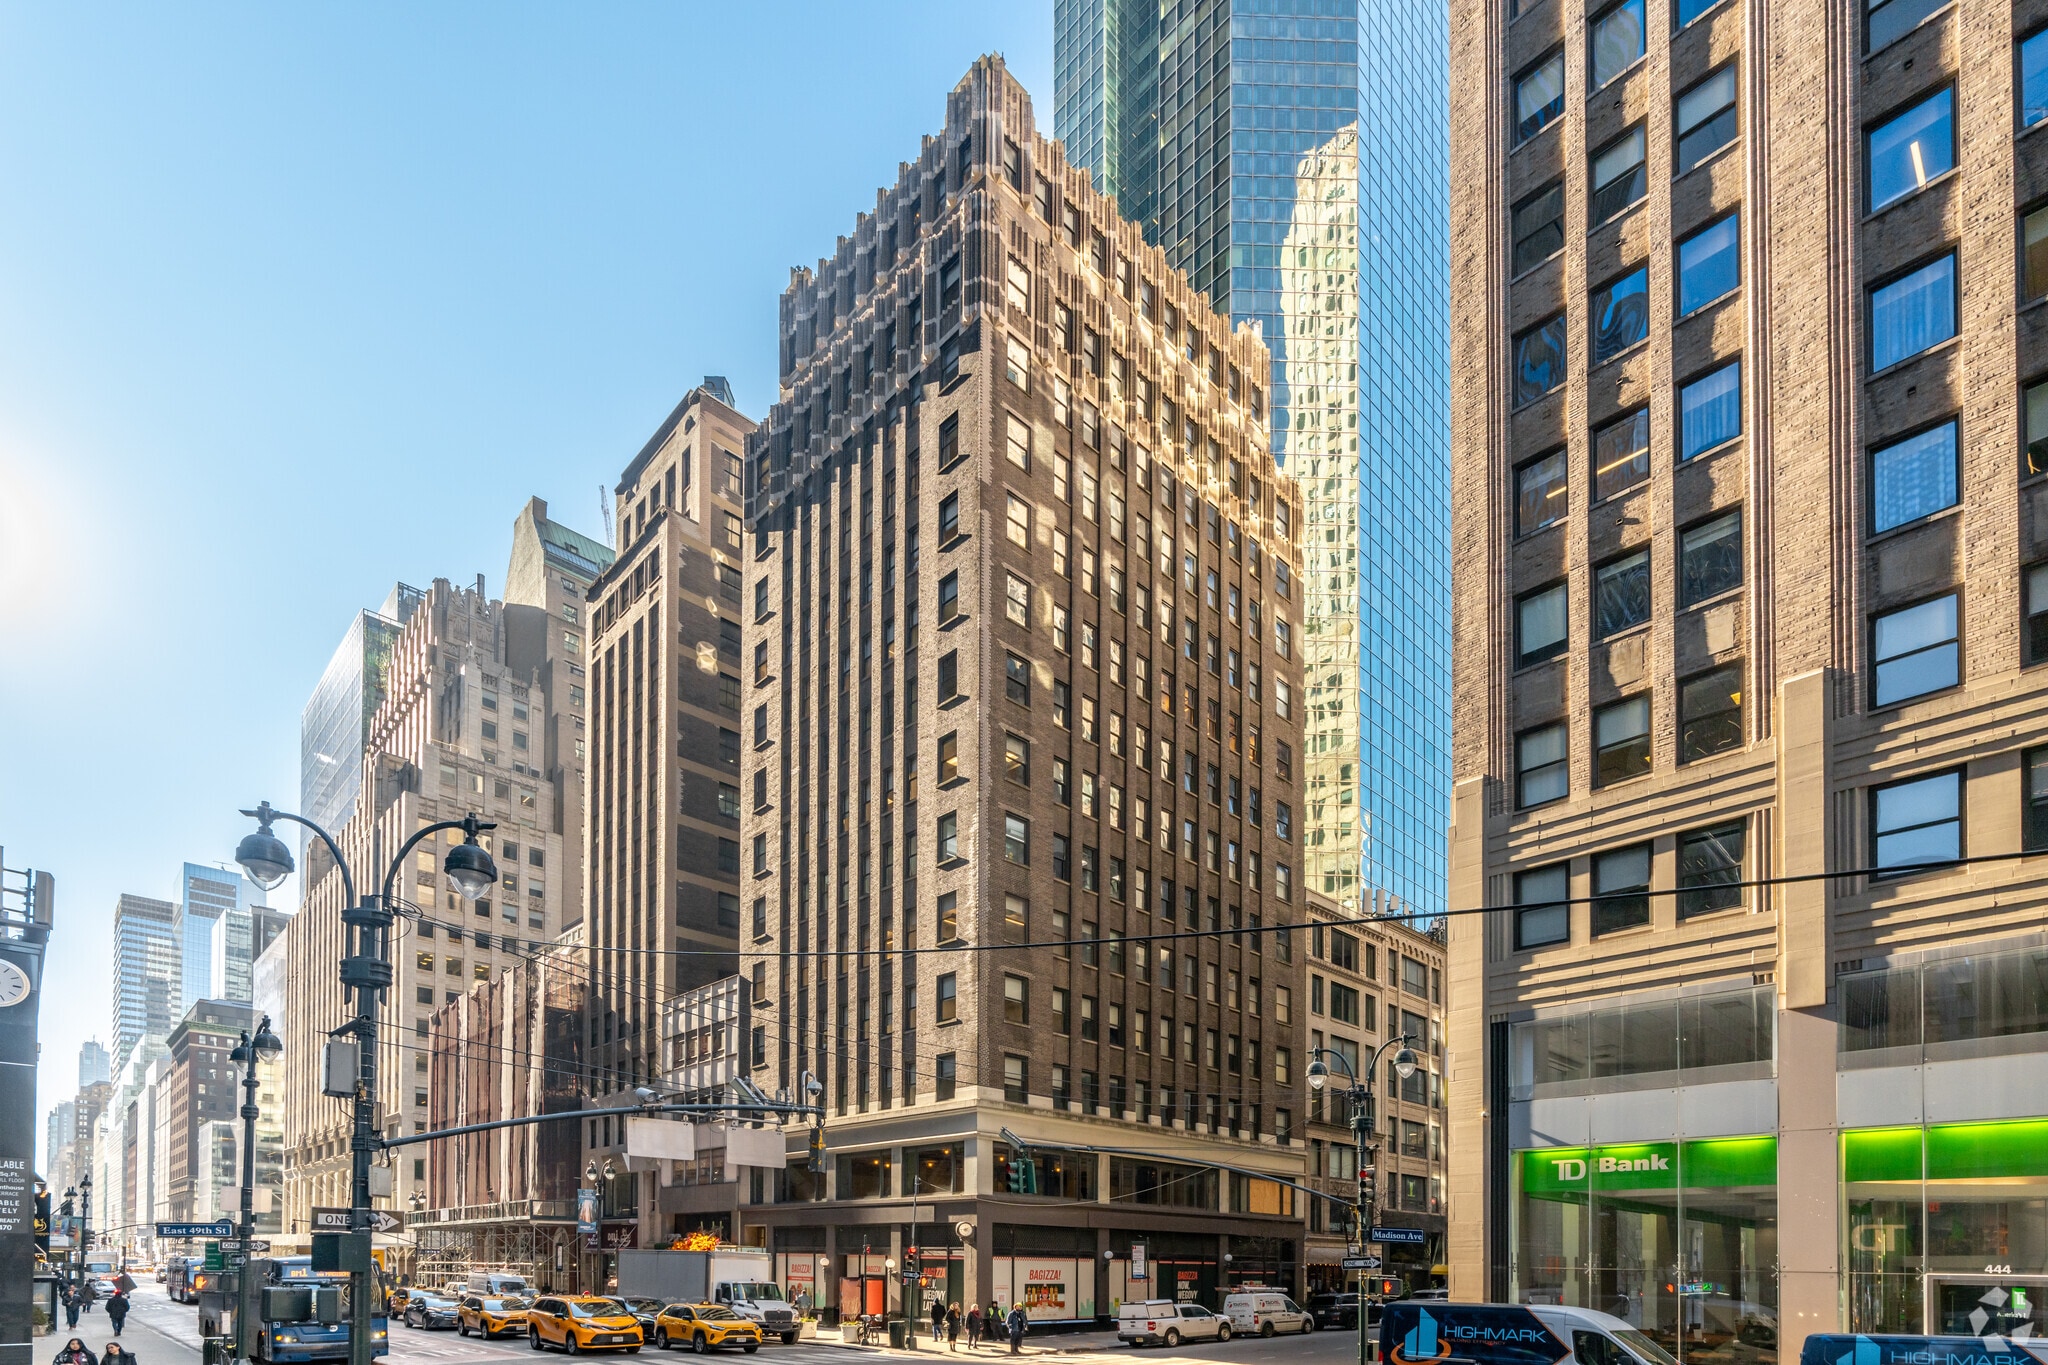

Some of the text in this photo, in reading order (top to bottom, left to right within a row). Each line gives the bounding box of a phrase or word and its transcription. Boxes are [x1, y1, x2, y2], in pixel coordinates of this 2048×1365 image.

[1551, 1153, 1670, 1181] TD Bank
[325, 1215, 351, 1224] ONE
[189, 1226, 212, 1234] 49th
[215, 1226, 227, 1234] St
[1373, 1231, 1423, 1241] Madison Ave
[1984, 1264, 2012, 1274] 444
[1029, 1269, 1062, 1280] BAGIZZA!
[922, 1290, 946, 1301] WEGOVY
[1177, 1290, 1198, 1300] WEGOVY
[1444, 1325, 1546, 1343] HIGHMARK
[1891, 1351, 2031, 1365] HIGHMARK
